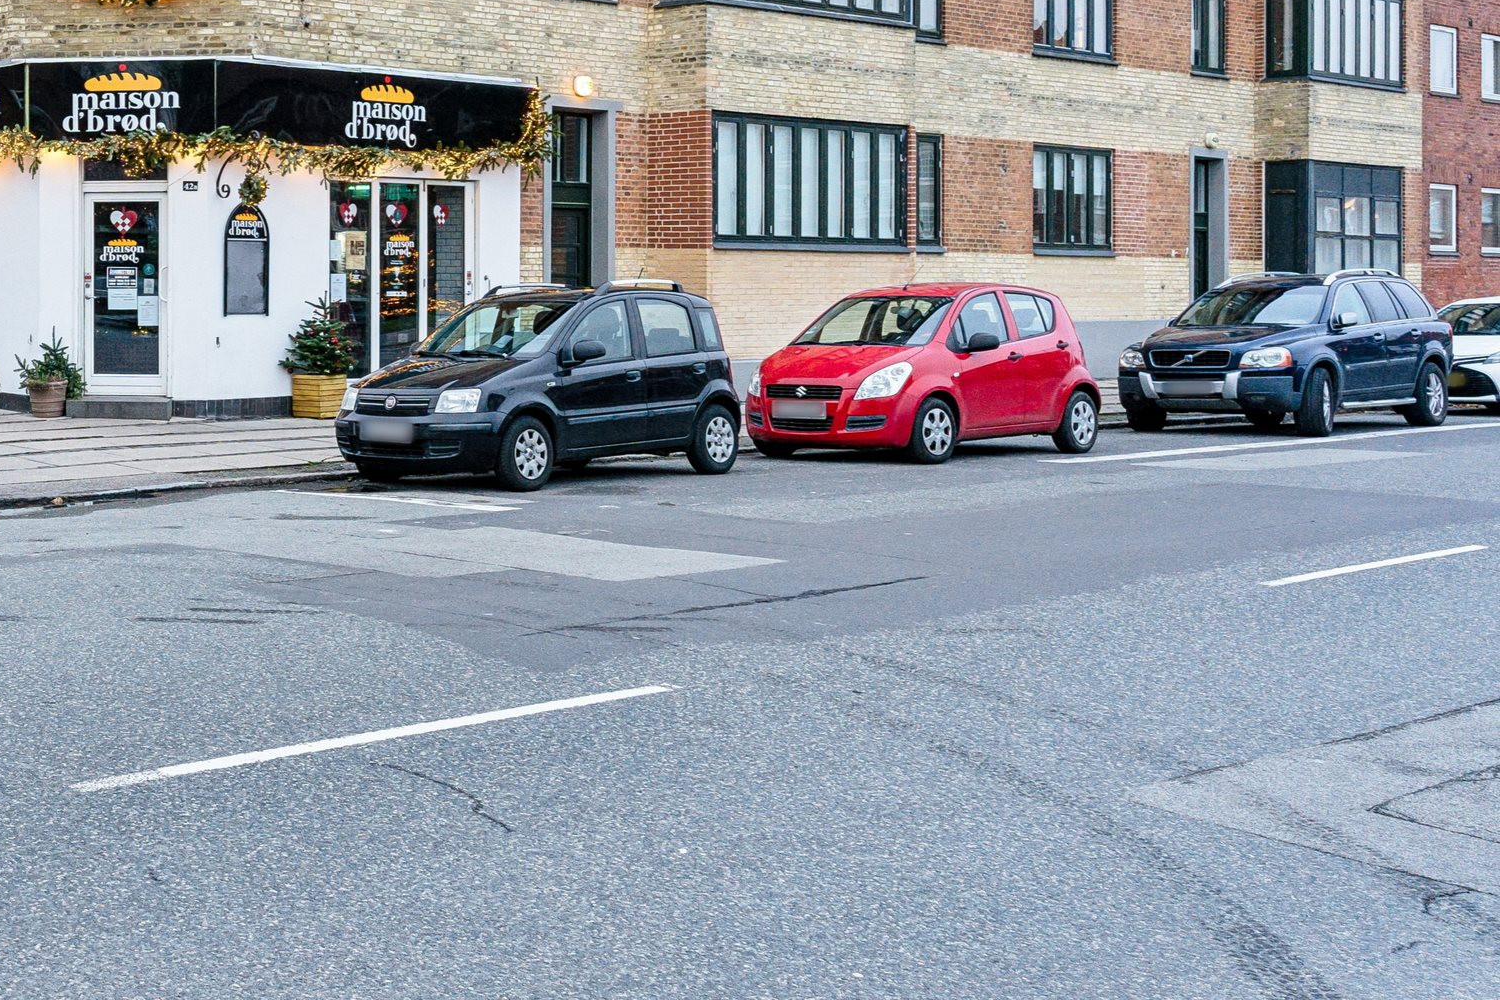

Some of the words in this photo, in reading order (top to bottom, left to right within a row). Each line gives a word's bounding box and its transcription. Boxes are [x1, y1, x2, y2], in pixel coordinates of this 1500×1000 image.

[70, 91, 181, 110] maison
[352, 101, 427, 122] maison
[62, 108, 167, 136] d'brød
[344, 117, 417, 148] d'brød
[231, 220, 263, 228] maison
[103, 245, 145, 254] maison
